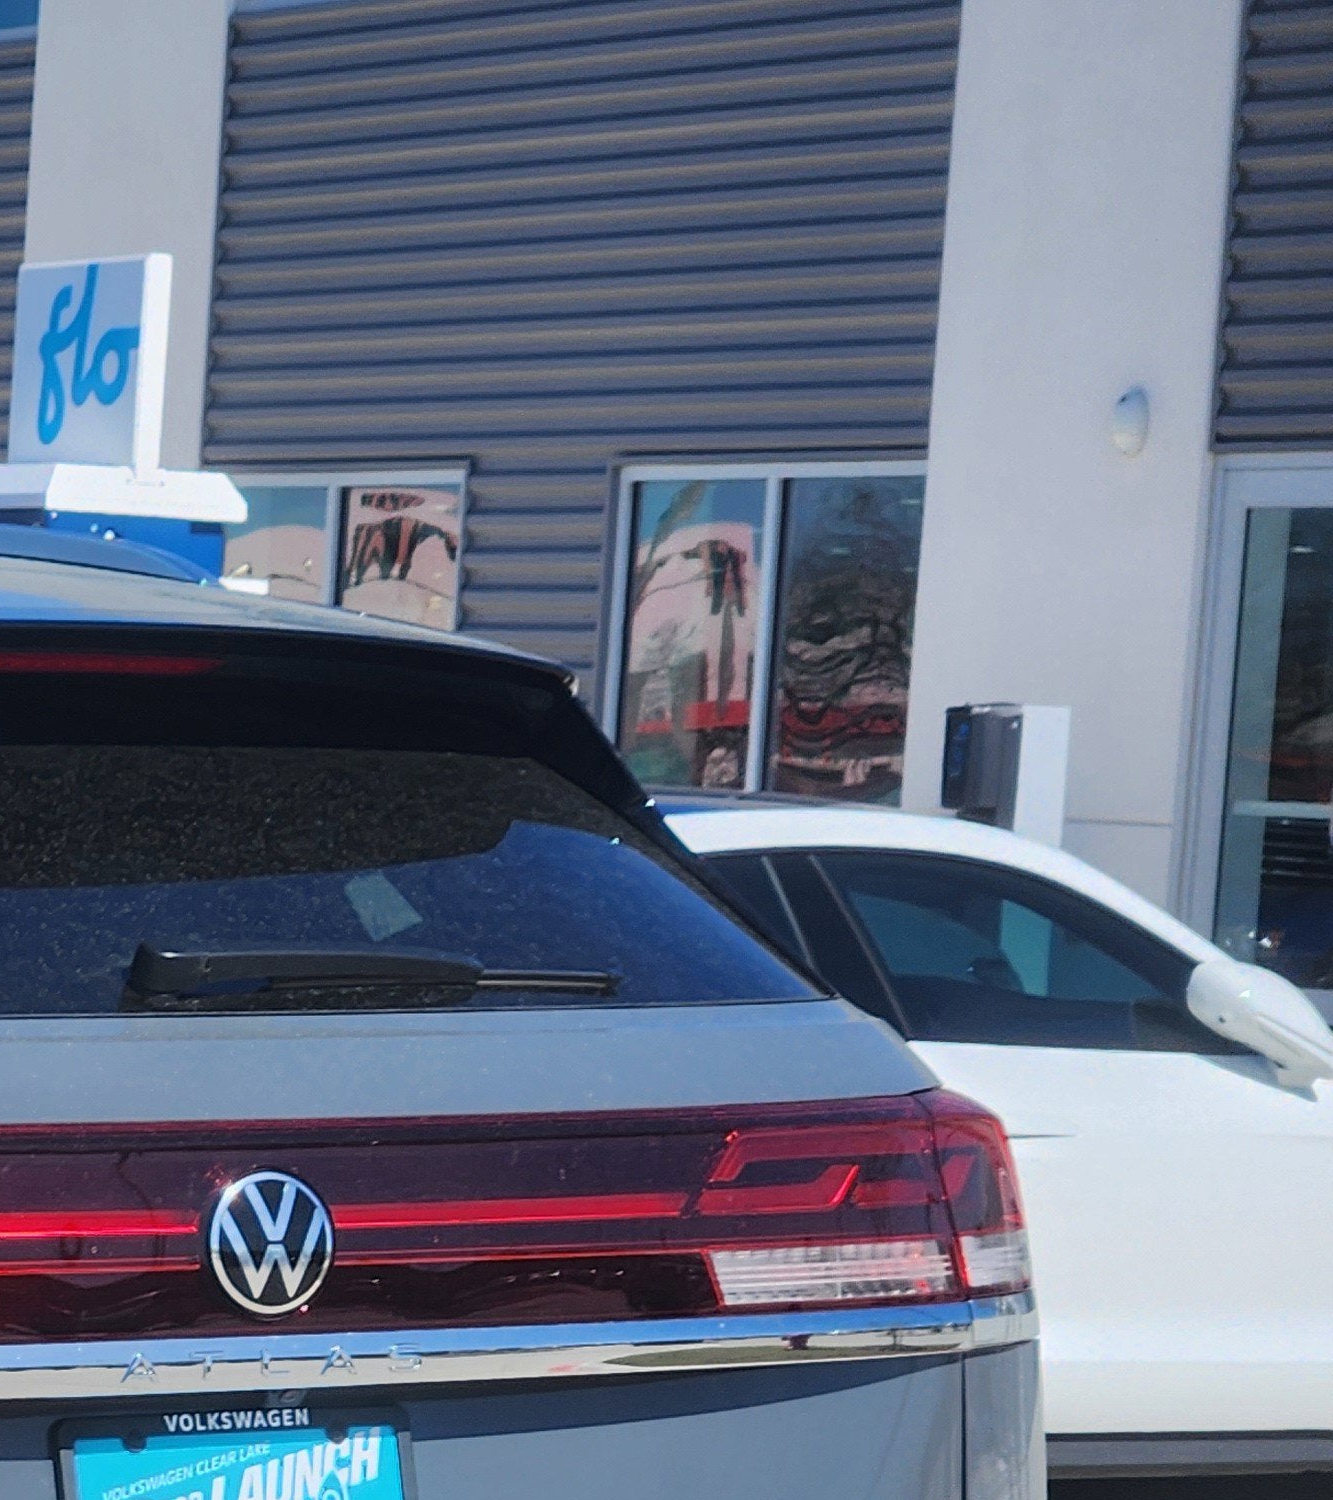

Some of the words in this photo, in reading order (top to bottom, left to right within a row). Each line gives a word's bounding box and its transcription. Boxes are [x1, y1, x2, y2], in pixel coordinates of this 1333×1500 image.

[37, 264, 140, 445] flo
[120, 1342, 425, 1386] ATLAS
[162, 1406, 310, 1433] VOLKSWAGEN
[194, 1449, 237, 1476] CLEAR
[238, 1442, 272, 1463] LAKE
